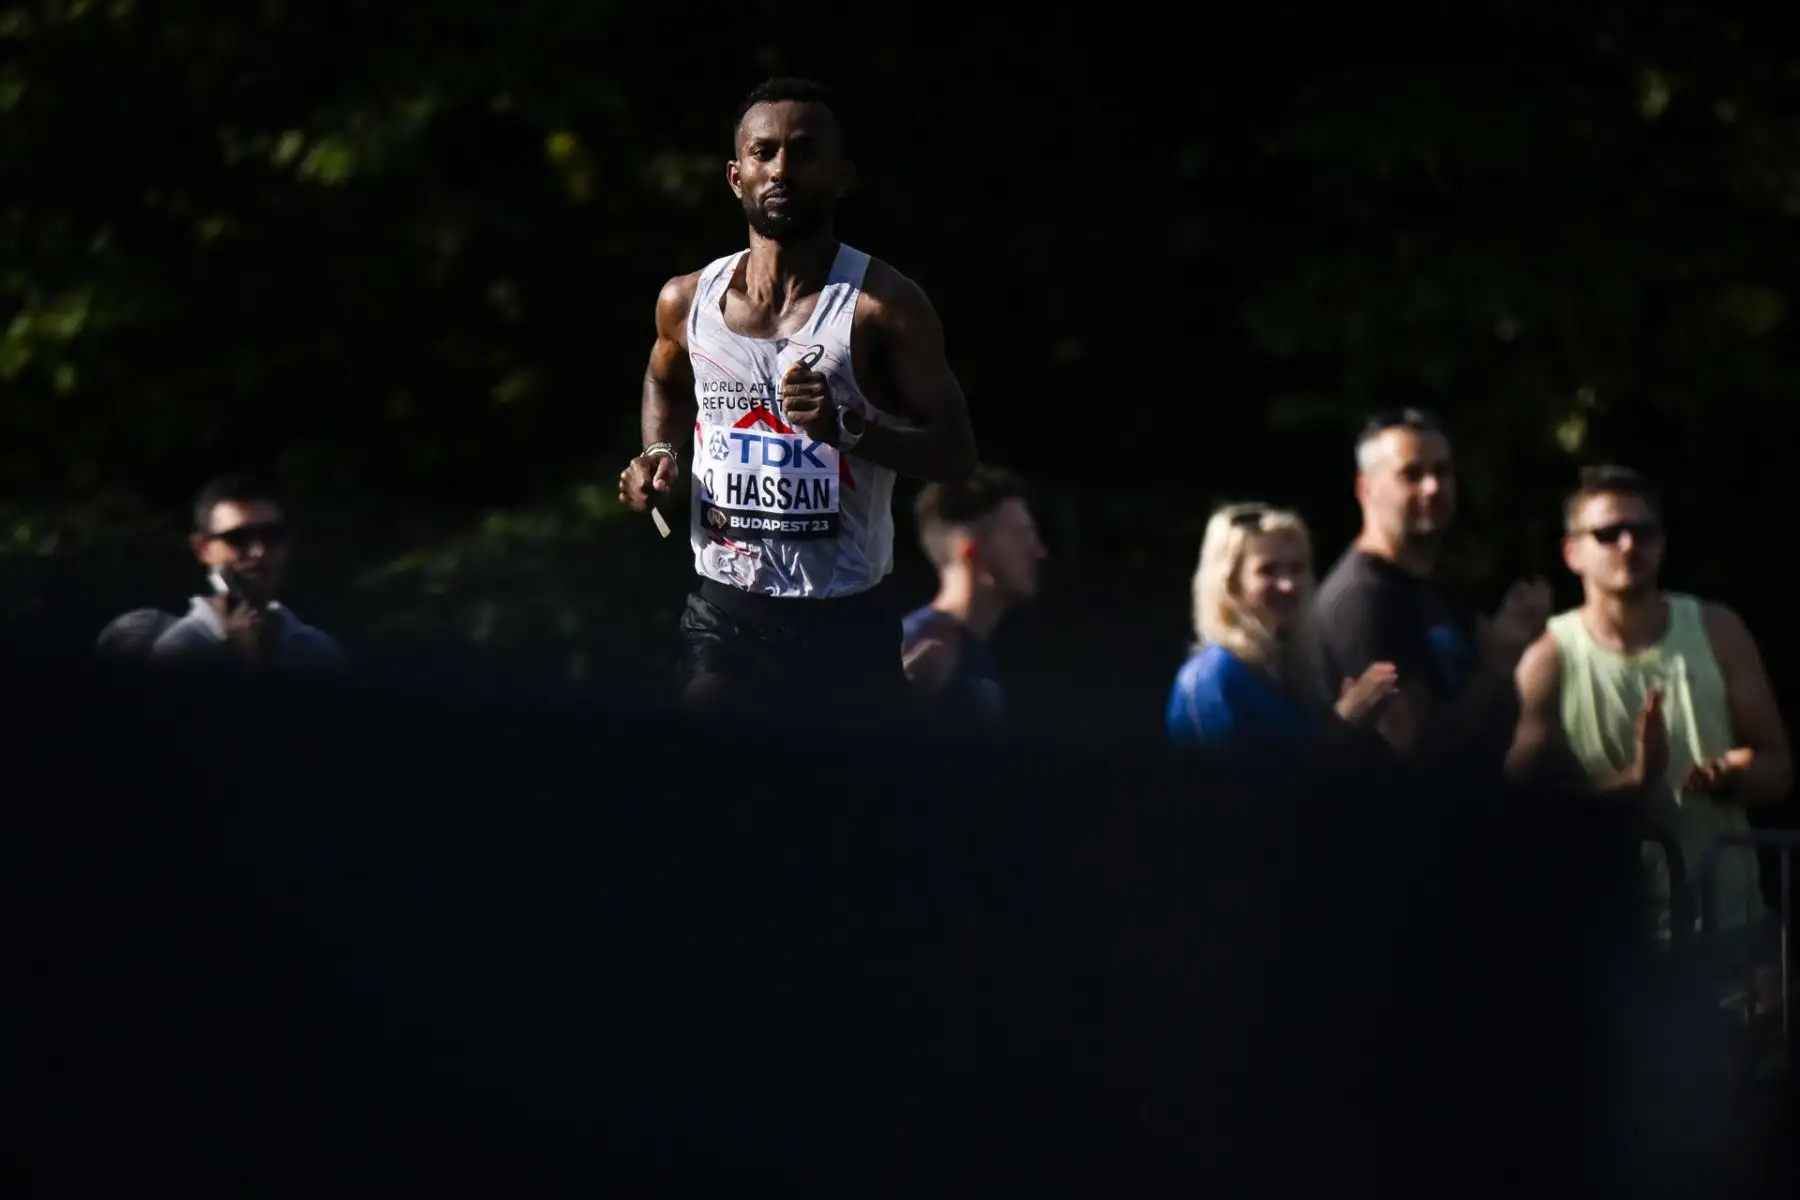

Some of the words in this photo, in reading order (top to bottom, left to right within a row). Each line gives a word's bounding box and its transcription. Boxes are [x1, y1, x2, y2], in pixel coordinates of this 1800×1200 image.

[702, 381, 745, 393] WORLD
[749, 383, 783, 395] ATHL
[702, 396, 771, 411] REFUGEE
[730, 432, 827, 469] TDK
[727, 472, 830, 510] HASSAN
[730, 516, 809, 531] BUDAPEST
[812, 520, 829, 531] 23
